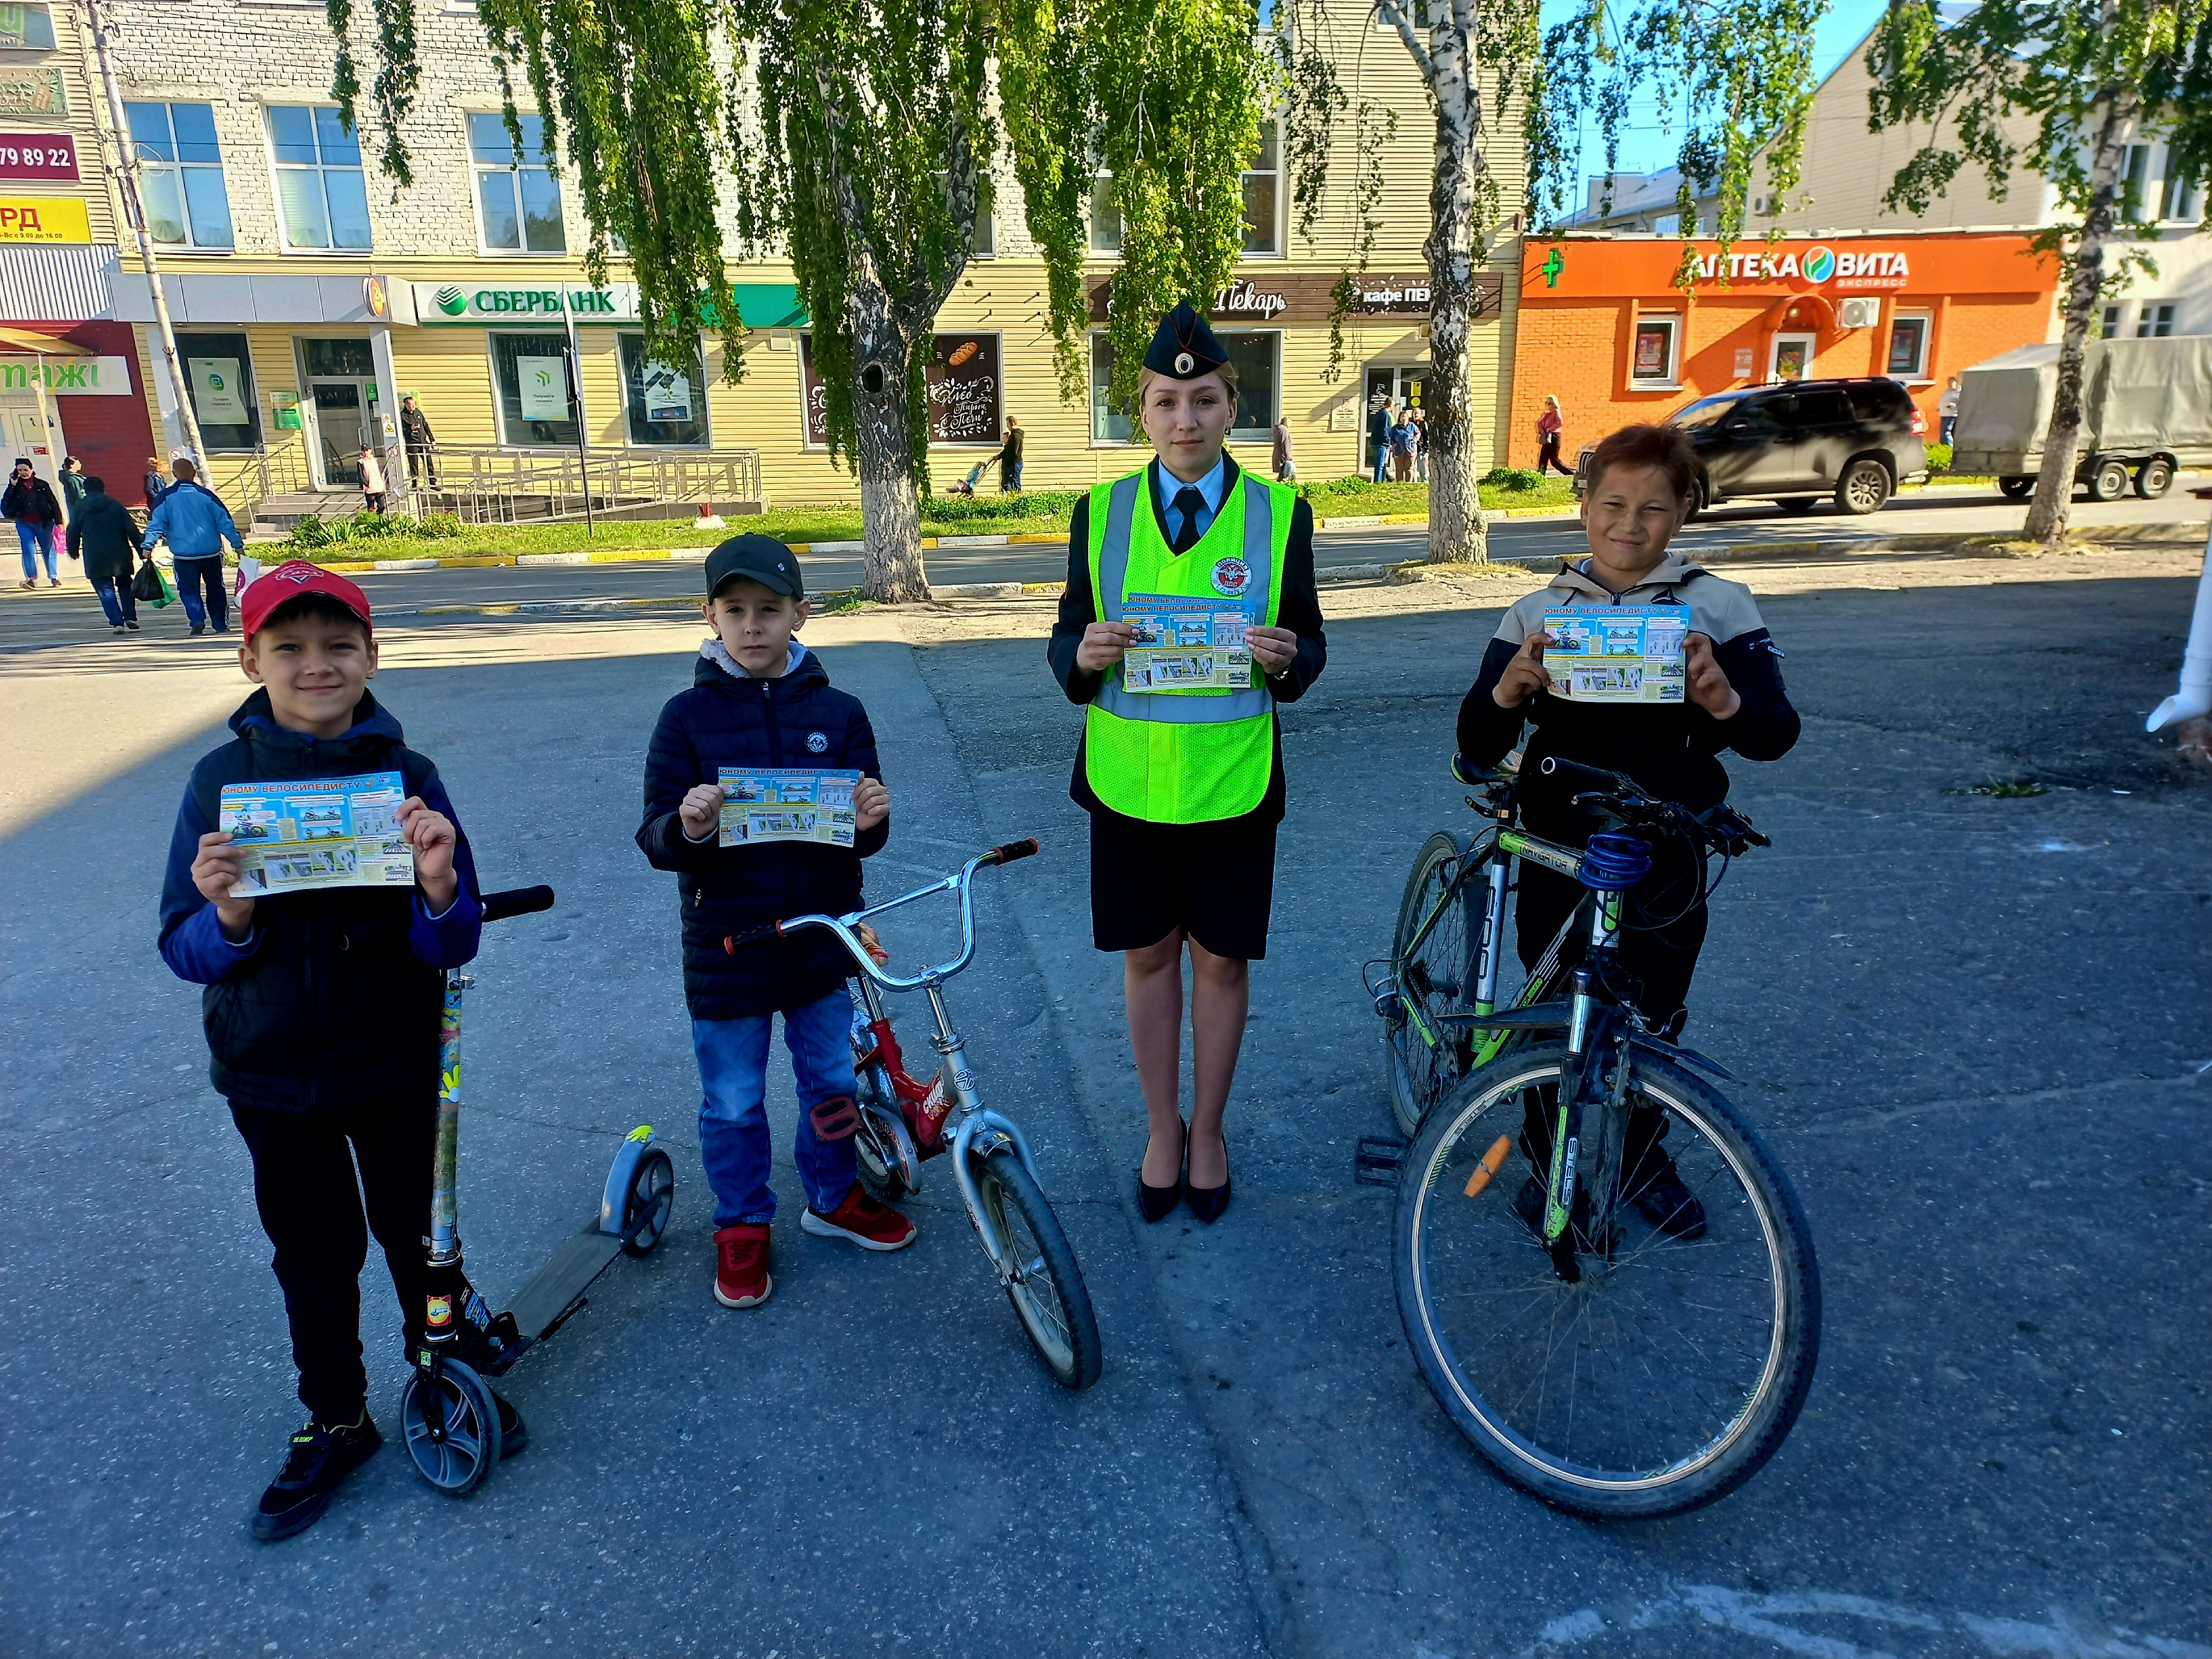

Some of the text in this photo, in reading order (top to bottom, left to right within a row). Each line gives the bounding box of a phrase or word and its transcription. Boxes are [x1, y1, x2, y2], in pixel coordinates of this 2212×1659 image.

[22, 148, 44, 166] 89
[48, 149, 71, 166] 22
[1688, 252, 1910, 278] АПТЕКА ВИТА
[1837, 279, 1908, 287] ЭКСПРЕСС
[475, 290, 616, 312] СБЕРБАНК
[1363, 288, 1402, 305] кафе
[222, 782, 360, 794] ЮНОМУ ВЕЛОСИПЕДИСТУ
[1523, 844, 1568, 871] NAVIGATOR
[1562, 1138, 1578, 1206] STELS
